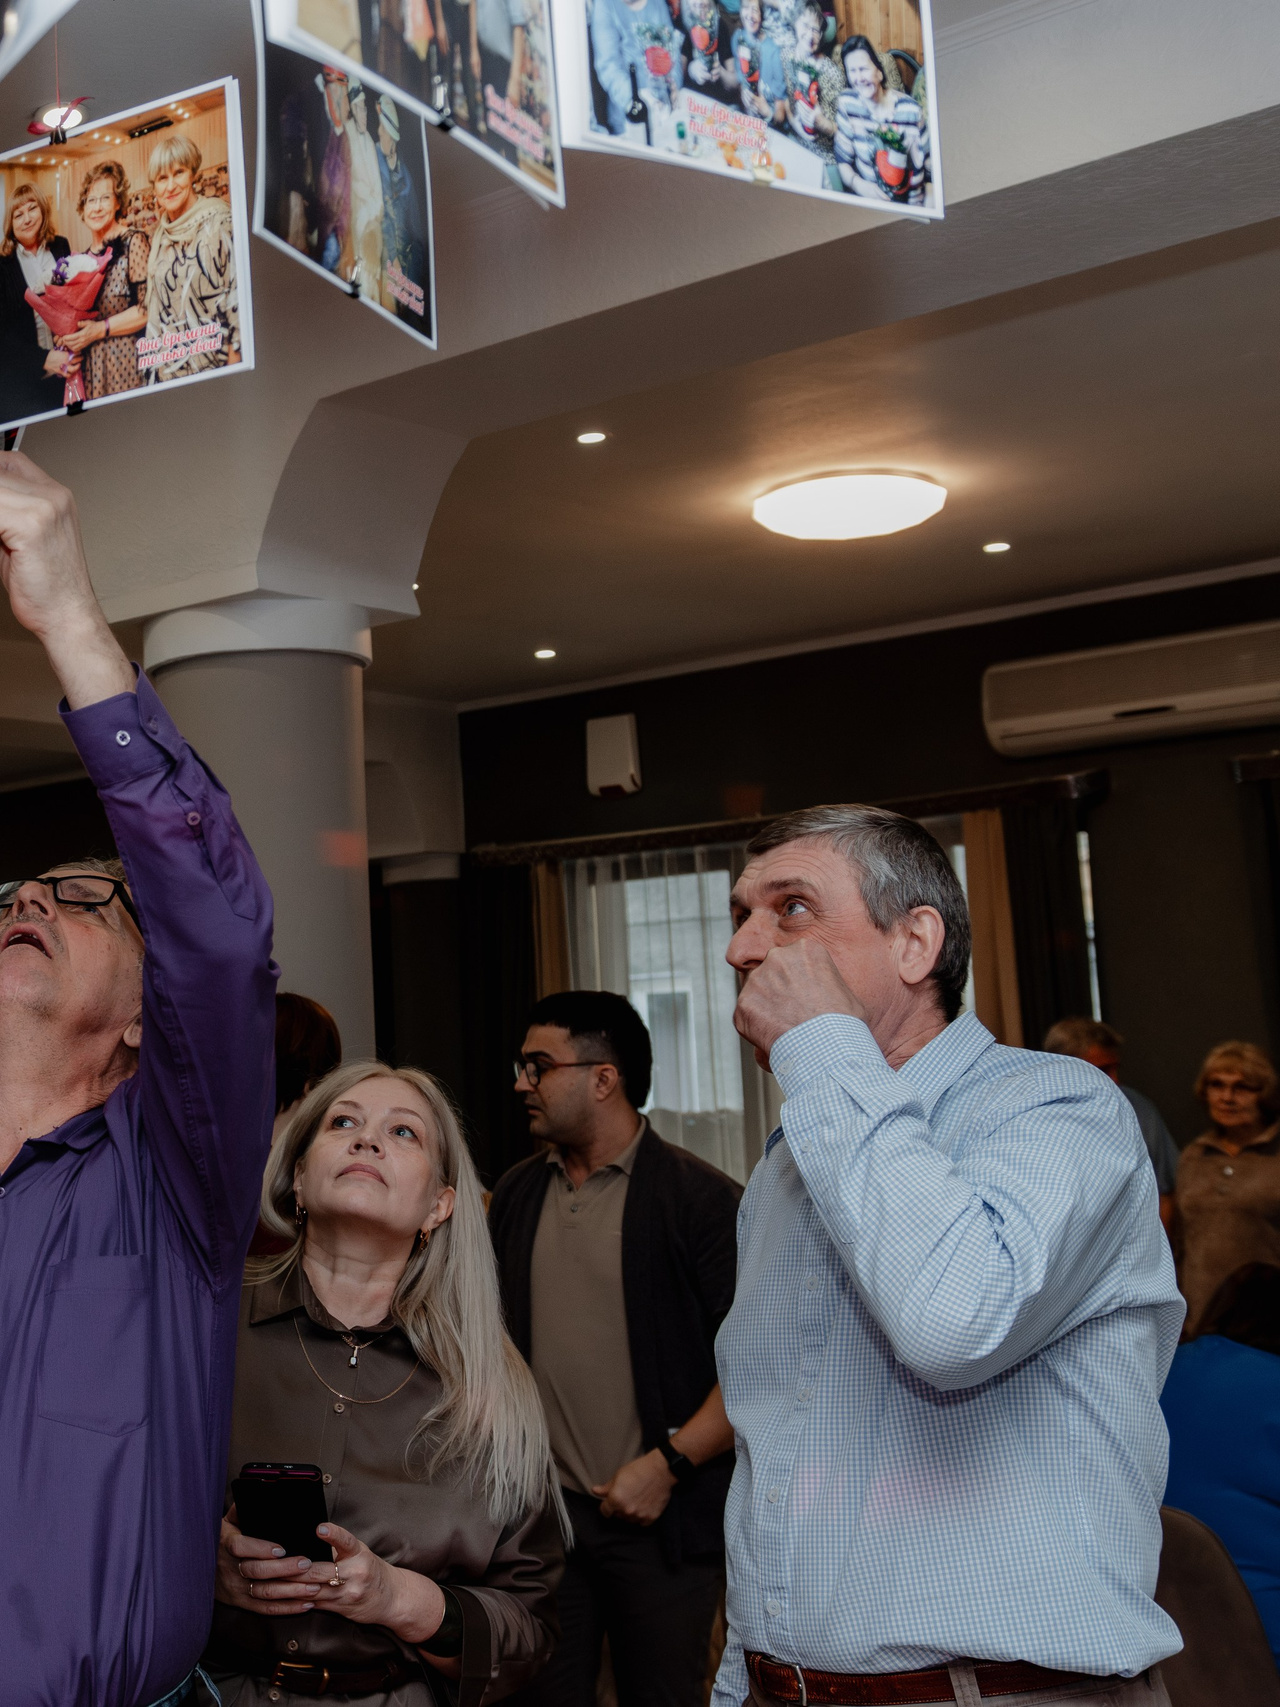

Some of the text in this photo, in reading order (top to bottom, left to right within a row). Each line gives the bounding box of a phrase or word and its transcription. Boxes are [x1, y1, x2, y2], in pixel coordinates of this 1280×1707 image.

[137, 322, 221, 353] Вне времени:
[138, 333, 223, 369] только свои!
